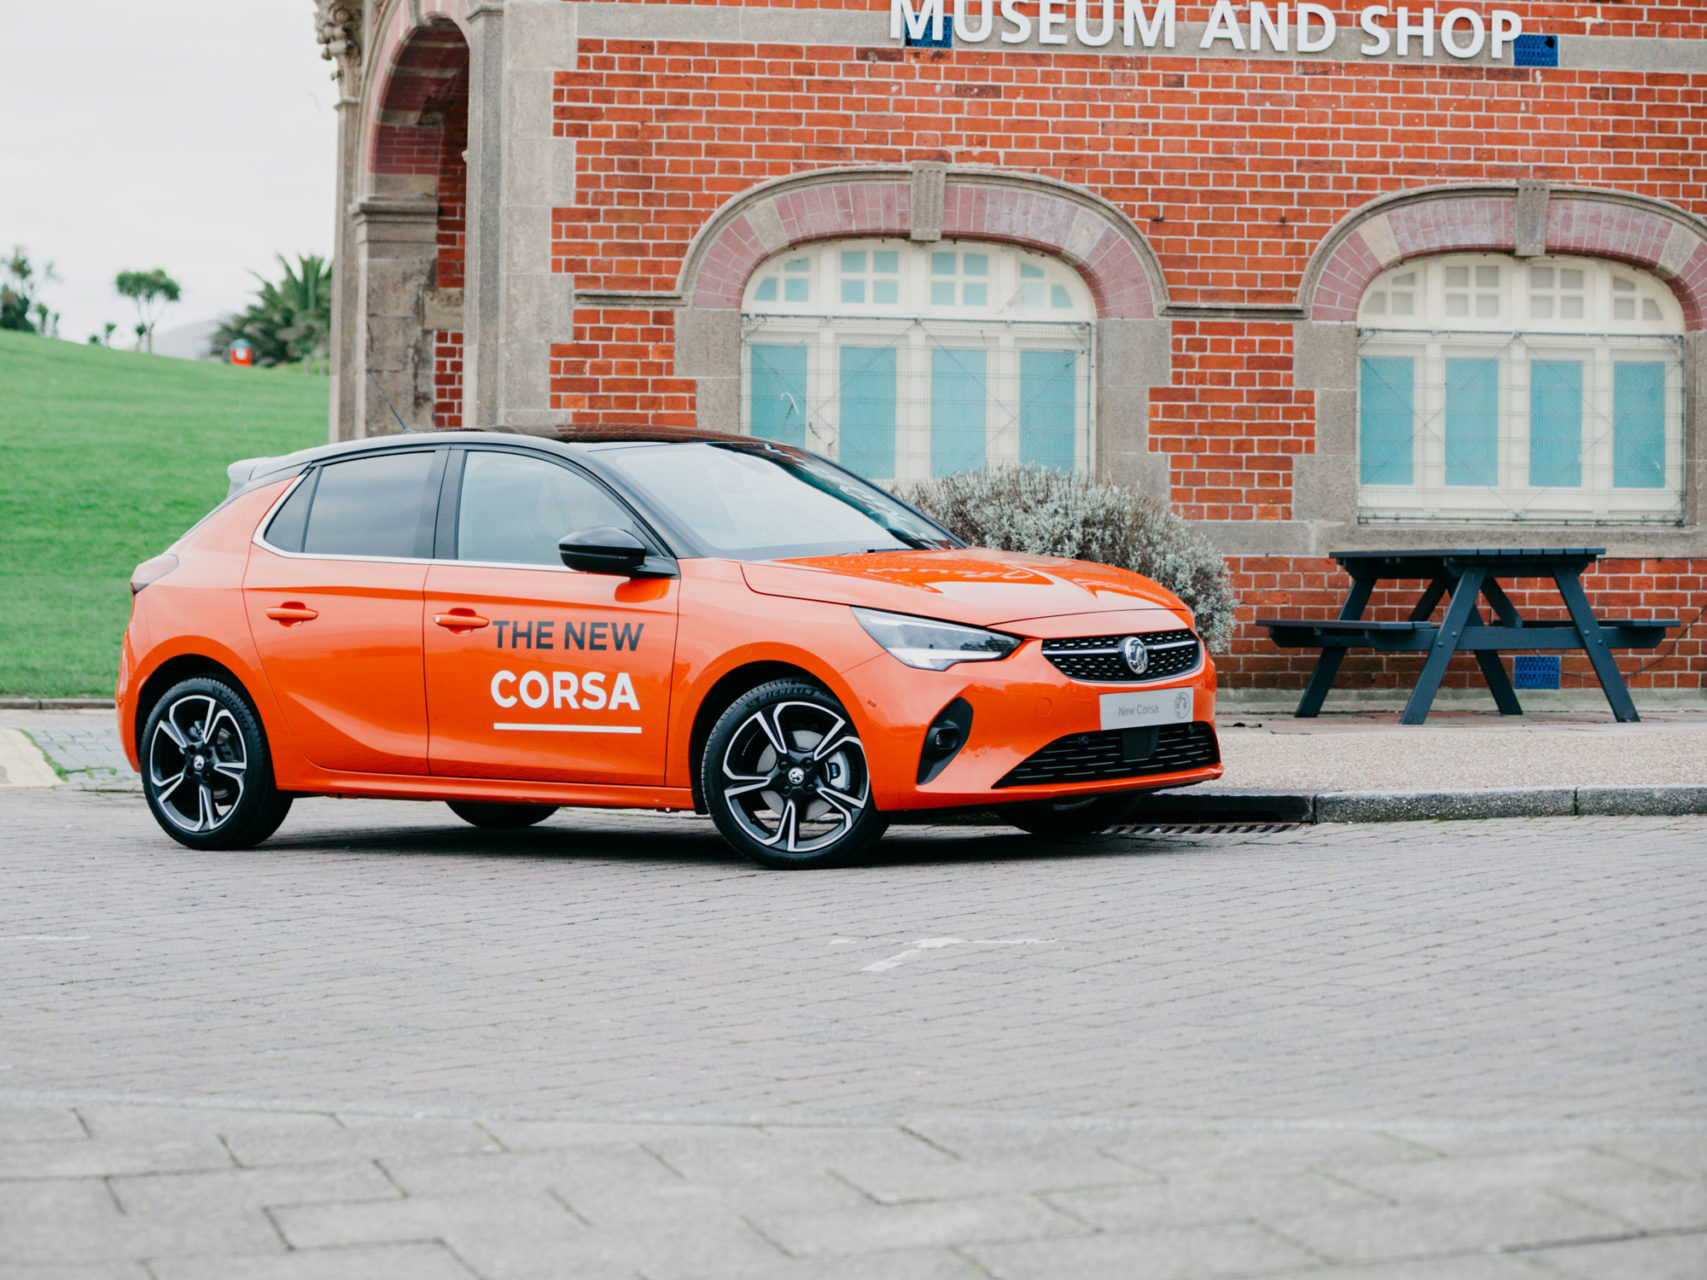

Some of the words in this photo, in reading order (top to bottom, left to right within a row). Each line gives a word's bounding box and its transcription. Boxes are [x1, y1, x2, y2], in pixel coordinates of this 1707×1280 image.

[1198, 0, 1338, 55] AND
[1359, 4, 1523, 59] SHOP
[492, 620, 555, 650] THE
[564, 621, 645, 652] NEW
[490, 669, 641, 711] CORSA
[1118, 705, 1135, 717] New
[1136, 703, 1160, 716] Corsa
